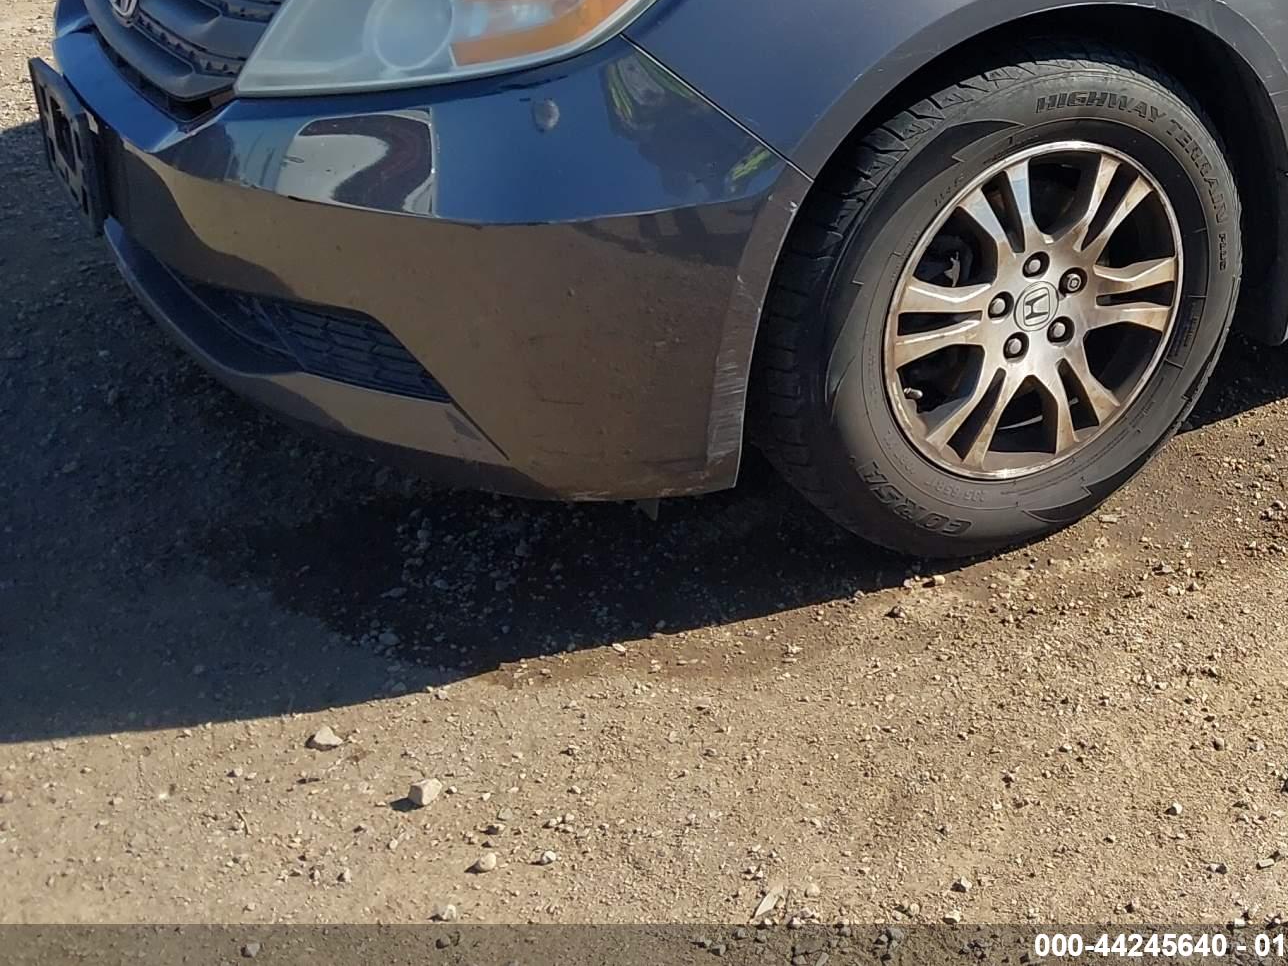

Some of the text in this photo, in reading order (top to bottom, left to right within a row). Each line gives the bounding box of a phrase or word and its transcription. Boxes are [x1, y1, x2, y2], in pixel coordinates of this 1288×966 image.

[1036, 91, 1166, 123] HIGHWAY
[1166, 119, 1228, 225] TERRAIN
[856, 459, 973, 536] CORSA
